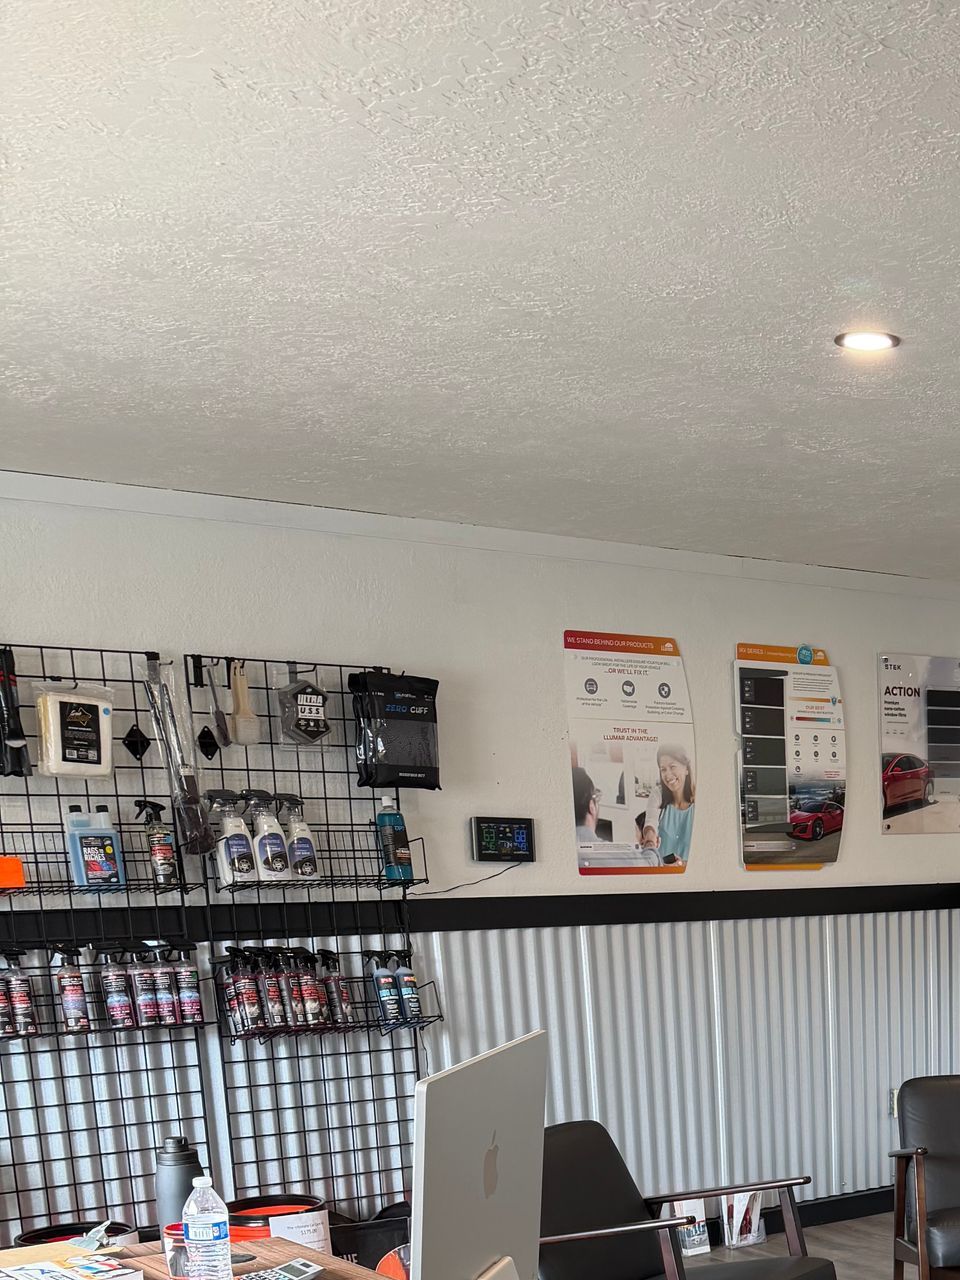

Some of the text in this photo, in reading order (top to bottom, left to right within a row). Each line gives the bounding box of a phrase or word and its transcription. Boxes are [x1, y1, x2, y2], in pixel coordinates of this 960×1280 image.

[884, 686, 920, 697] ACTION
[385, 704, 428, 714] ZERO CUFF
